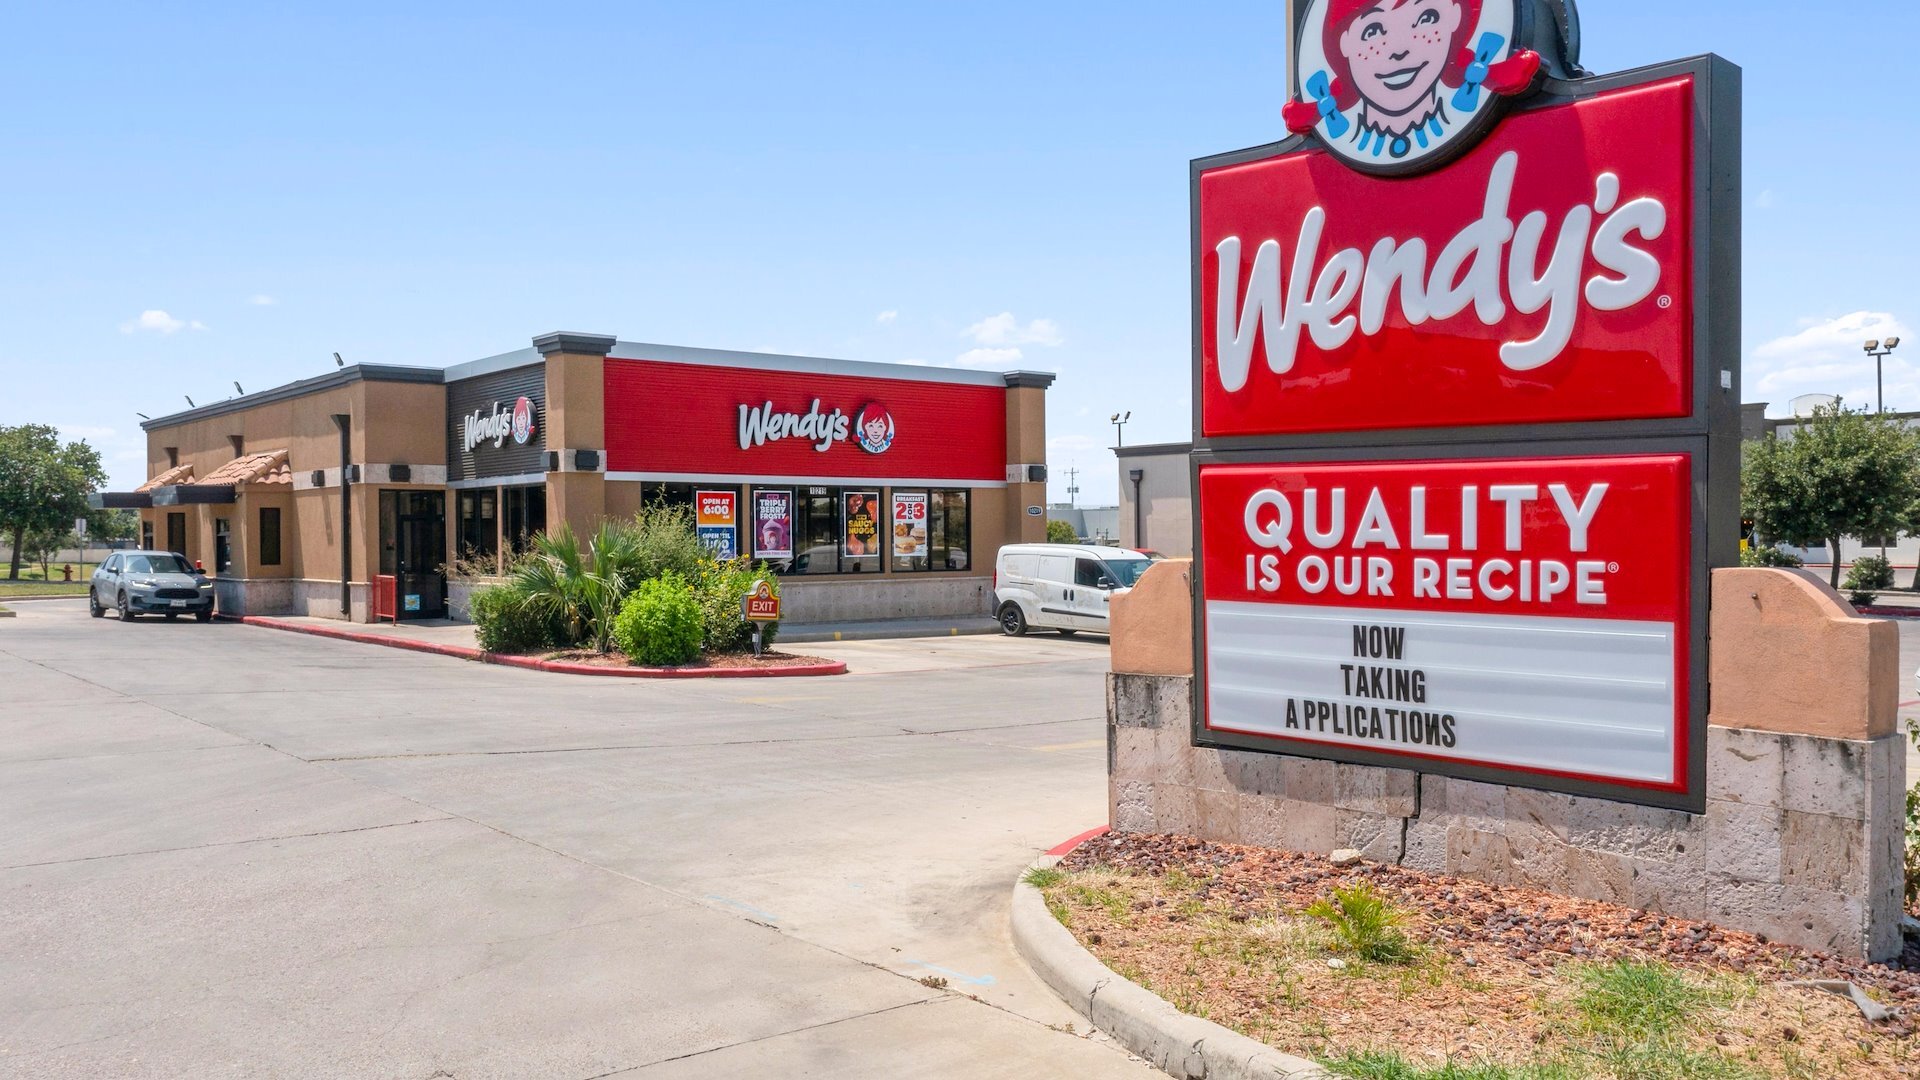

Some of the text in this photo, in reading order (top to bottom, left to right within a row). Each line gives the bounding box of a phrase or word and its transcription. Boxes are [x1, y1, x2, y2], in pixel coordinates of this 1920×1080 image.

[1216, 151, 1667, 393] Wendy's
[464, 401, 511, 452] Wendy's
[739, 398, 849, 452] Wendy's
[703, 505, 729, 515] 6:00
[760, 499, 786, 507] TRIPLE
[760, 506, 786, 514] BERRY
[896, 502, 907, 519] 2
[848, 520, 873, 528] SAUCY
[848, 527, 875, 535] NUGGS
[1244, 483, 1609, 555] QUALITY
[1245, 554, 1281, 592] IS
[1297, 555, 1395, 597] OUR
[752, 600, 775, 612] EXIT
[1353, 624, 1406, 660] NOW
[1340, 664, 1426, 704] TAKING
